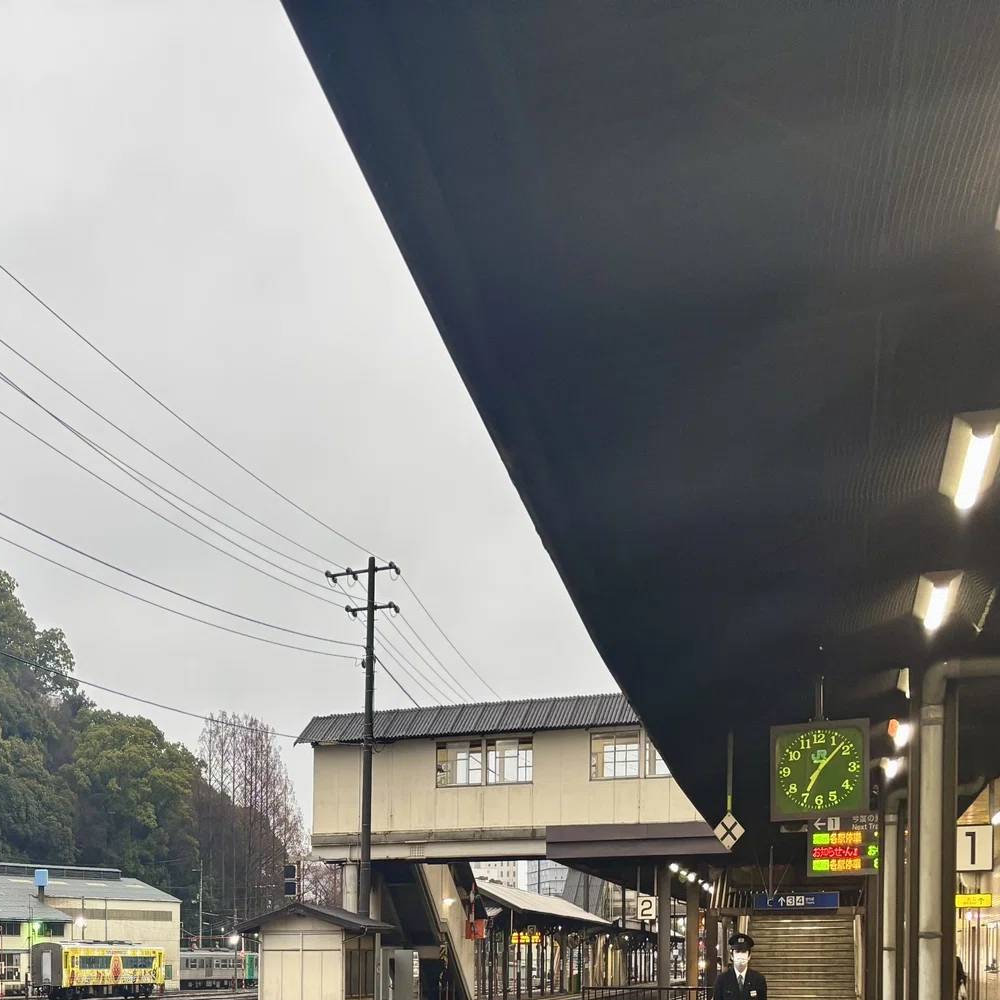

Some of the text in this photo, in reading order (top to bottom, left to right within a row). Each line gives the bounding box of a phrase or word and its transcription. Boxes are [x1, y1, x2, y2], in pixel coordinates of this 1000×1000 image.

[800, 739, 811, 749] 11
[813, 733, 826, 744] 12
[831, 736, 836, 746] 1
[788, 750, 801, 761] 10
[811, 749, 827, 761] JR
[841, 745, 850, 756] 2
[782, 767, 791, 777] 9
[848, 762, 857, 772] 3
[789, 783, 797, 794] 8
[841, 779, 850, 790] 4
[801, 793, 809, 803] 7
[815, 795, 823, 805] 6
[828, 791, 837, 801] 5
[965, 831, 976, 865] 1
[641, 900, 653, 917] 2
